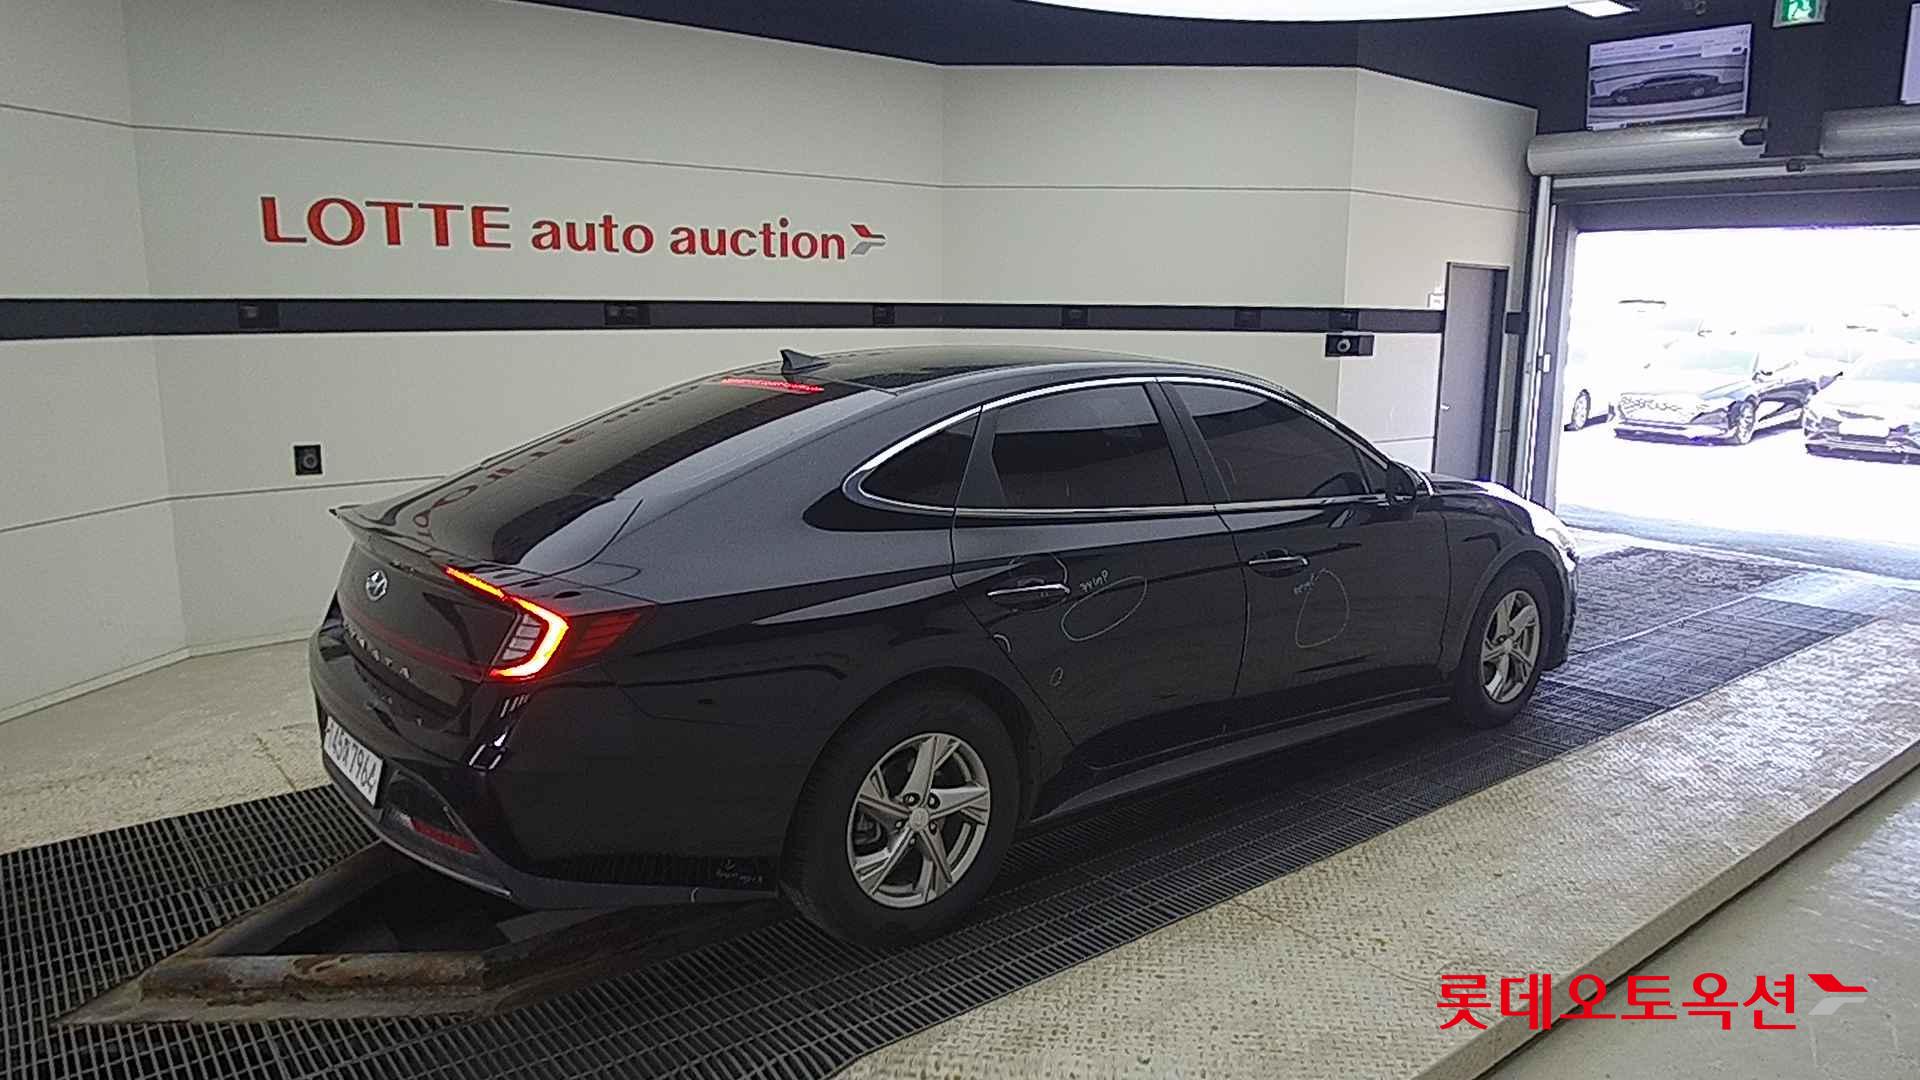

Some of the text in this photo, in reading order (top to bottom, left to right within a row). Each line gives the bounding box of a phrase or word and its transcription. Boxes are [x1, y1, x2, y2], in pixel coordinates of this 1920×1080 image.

[261, 197, 846, 260] LOTTE auto auction
